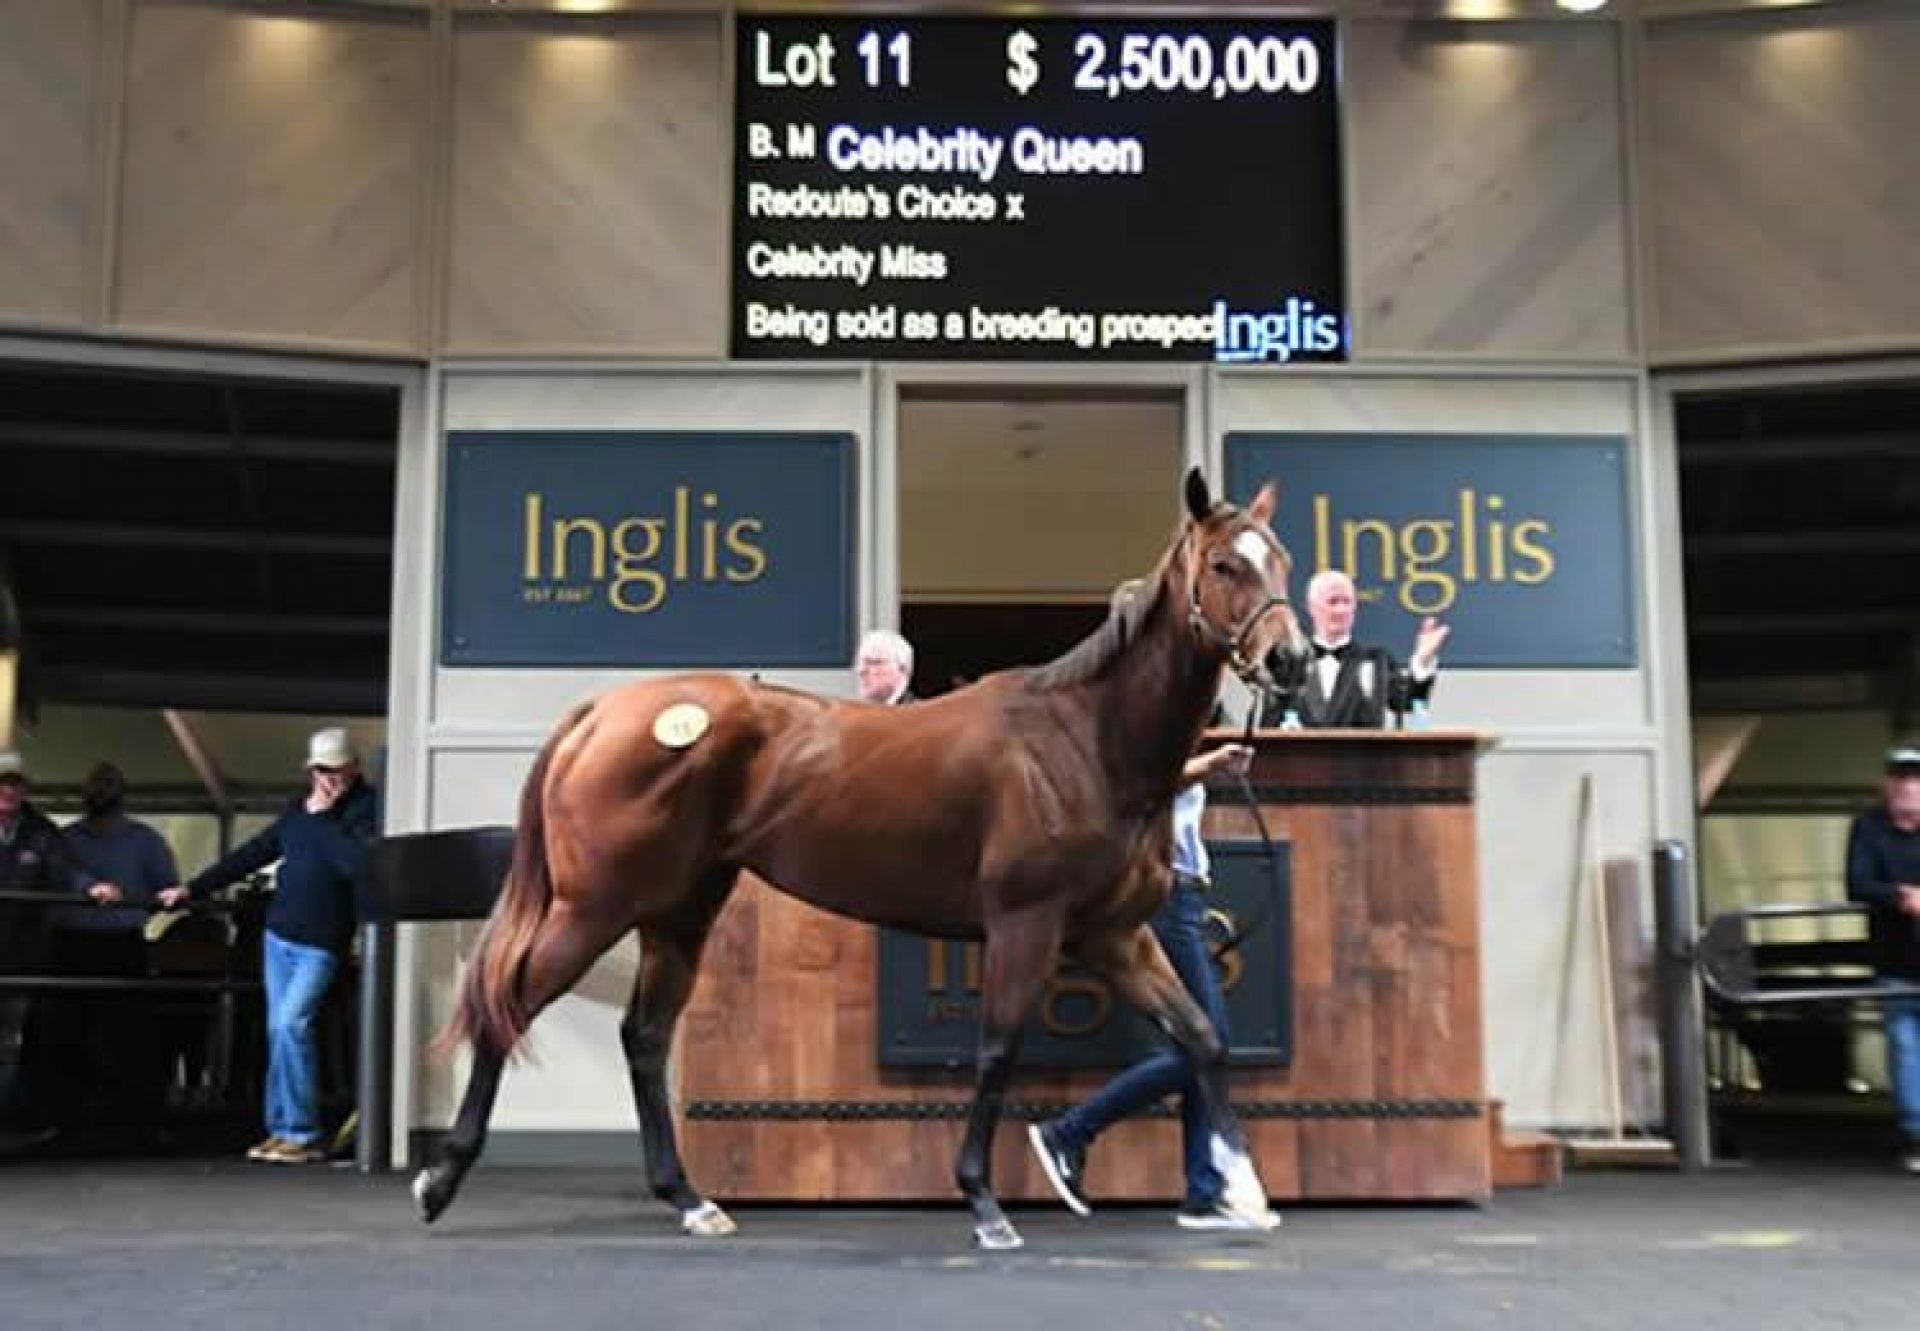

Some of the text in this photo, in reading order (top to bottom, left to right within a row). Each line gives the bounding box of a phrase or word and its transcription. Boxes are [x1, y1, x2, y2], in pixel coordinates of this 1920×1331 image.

[756, 29, 1320, 99] Lot 11 $ 2,500,000
[748, 121, 1145, 182] B. M Celebrity Queen
[746, 182, 1026, 219] Redoute's Choice x
[746, 242, 948, 287] Celebrity Miss
[746, 303, 1214, 349] Being sold as a breeding prospec
[1213, 297, 1340, 361] Inglis
[522, 486, 768, 613] Inglis
[1312, 488, 1556, 614] Inglis
